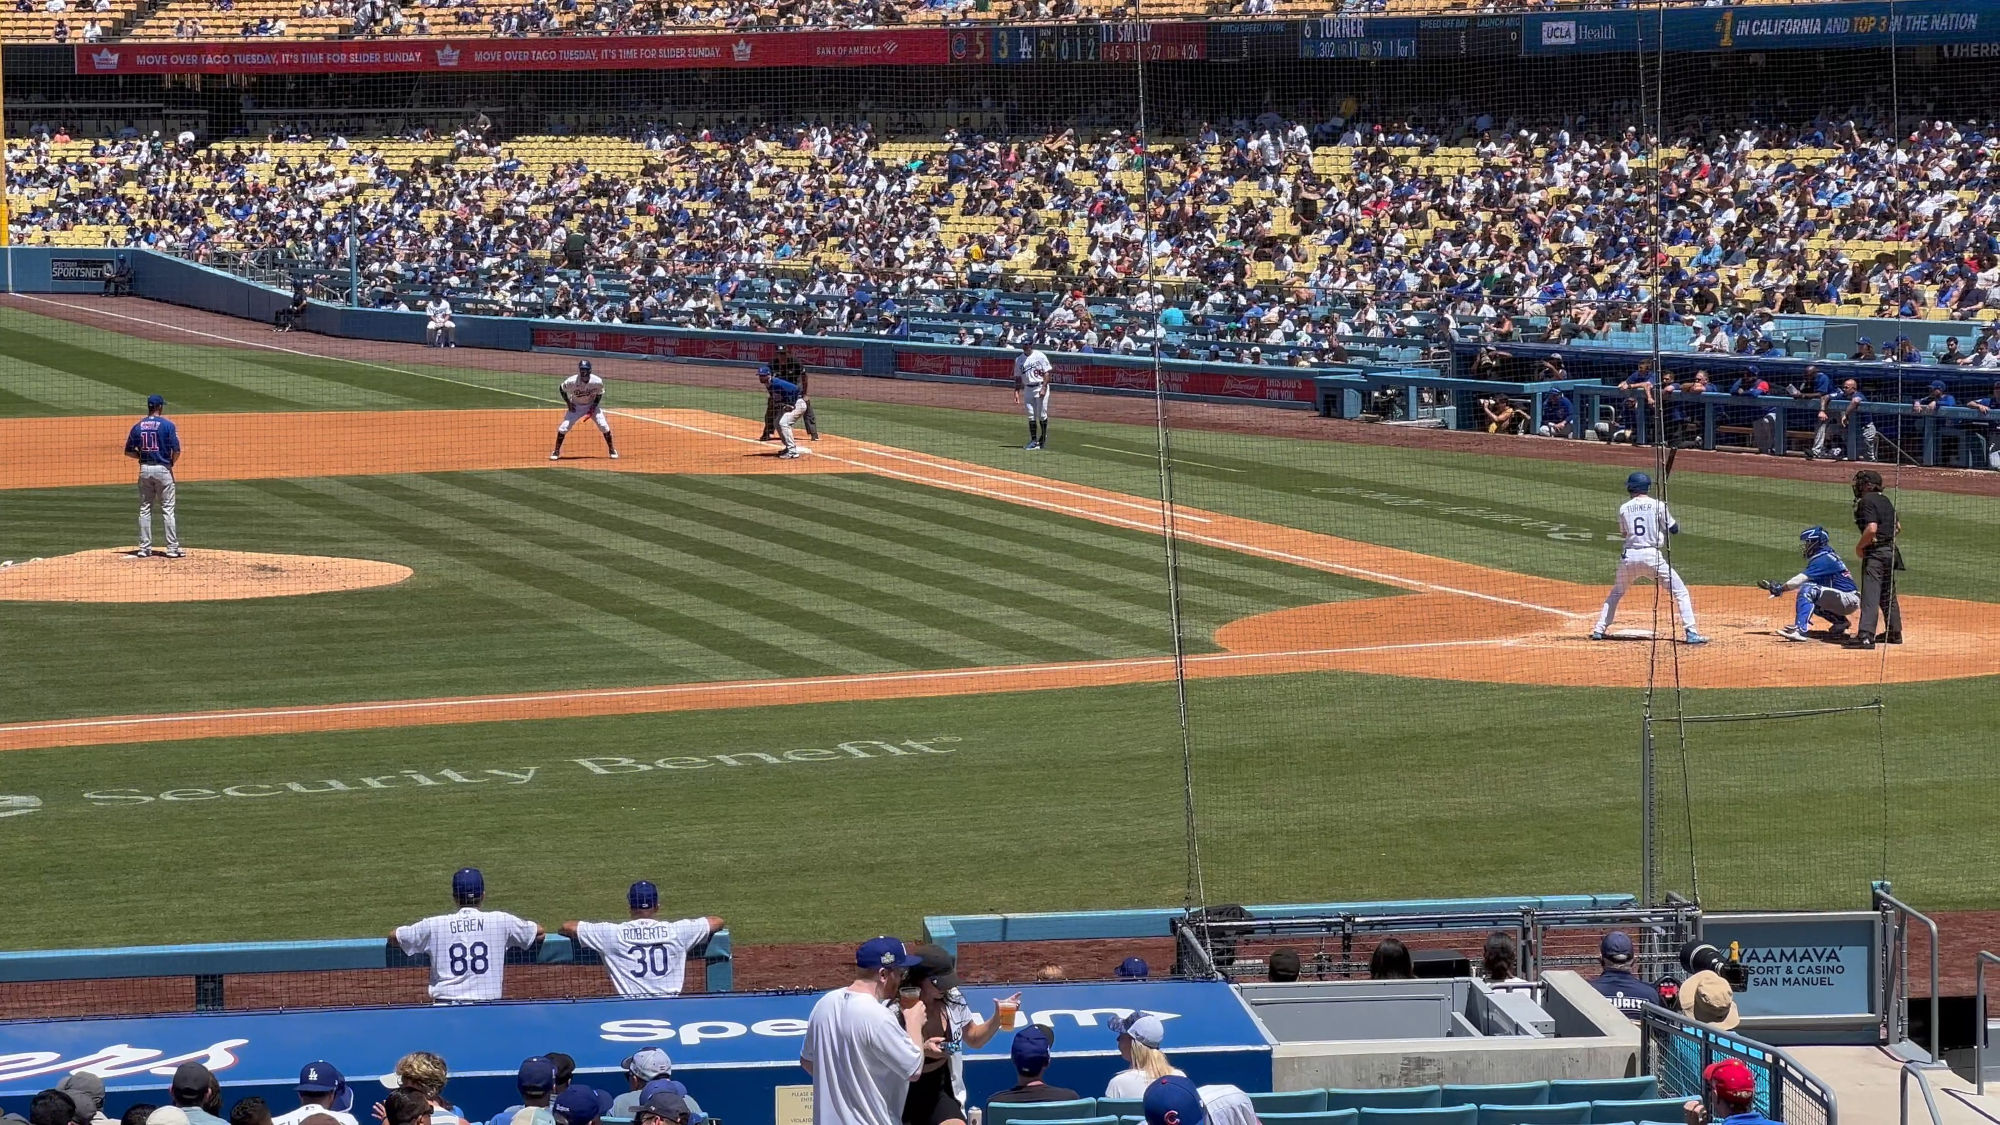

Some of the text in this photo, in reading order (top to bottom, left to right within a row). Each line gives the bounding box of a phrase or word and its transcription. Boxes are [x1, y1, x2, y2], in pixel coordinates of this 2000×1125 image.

[1220, 24, 1240, 33] PITCH
[1240, 24, 1262, 32] SPEED
[1268, 23, 1285, 32] TYPE
[1304, 18, 1365, 39] 6 TURNER
[1420, 19, 1441, 28] SPEED
[1442, 19, 1455, 28] OFF
[1477, 17, 1503, 27] LAUNCH
[1714, 10, 1978, 47] #1 IN CALIFORNIA AND TOP 3 IN THE NATION
[1039, 28, 1051, 36] INN
[1102, 23, 1152, 42] 11 SMLY
[1546, 24, 1616, 40] UCLA Health
[816, 45, 882, 56] BANK OF AMERICA
[975, 31, 985, 59] 5
[998, 31, 1009, 59] 3
[1019, 29, 1032, 59] LA
[1040, 40, 1047, 59] 2
[1061, 38, 1095, 60] 0 1 2
[1110, 45, 1120, 60] 45
[1151, 44, 1161, 60] 27
[1181, 44, 1198, 60] 4.26
[1317, 42, 1335, 57] .302
[1349, 41, 1358, 57] 11
[1372, 41, 1382, 57] 59
[1396, 39, 1408, 57] for
[136, 52, 423, 66] MOVE OVER TACO TUESDAY, IT'S TIME FOR SLIDER SUNDAY.
[474, 50, 502, 62] MOVE
[504, 50, 530, 61] OVER
[532, 50, 557, 61] TACO
[601, 49, 618, 60] IT'S
[619, 48, 638, 59] TIME
[640, 48, 657, 58] FOR
[659, 48, 686, 58] SLIDER
[687, 46, 721, 58] SUNDAY.
[52, 267, 103, 278] SPORTSNET
[950, 366, 974, 377] FOR YOU
[1266, 378, 1302, 389] THIS BUD'S
[1266, 388, 1294, 400] FOR YOU
[140, 431, 159, 452] 11
[1627, 503, 1653, 514] TURNER
[1633, 516, 1646, 537] 6
[82, 766, 540, 806] Security
[449, 918, 485, 934] GEREN
[623, 925, 668, 941] ROBERTS
[448, 941, 490, 976] 88
[627, 943, 669, 978] 30
[1747, 965, 1845, 975] SORT & CASINO
[1753, 977, 1835, 987] SAN MANUEL
[308, 1067, 318, 1081] LA
[1164, 1110, 1180, 1125] C
